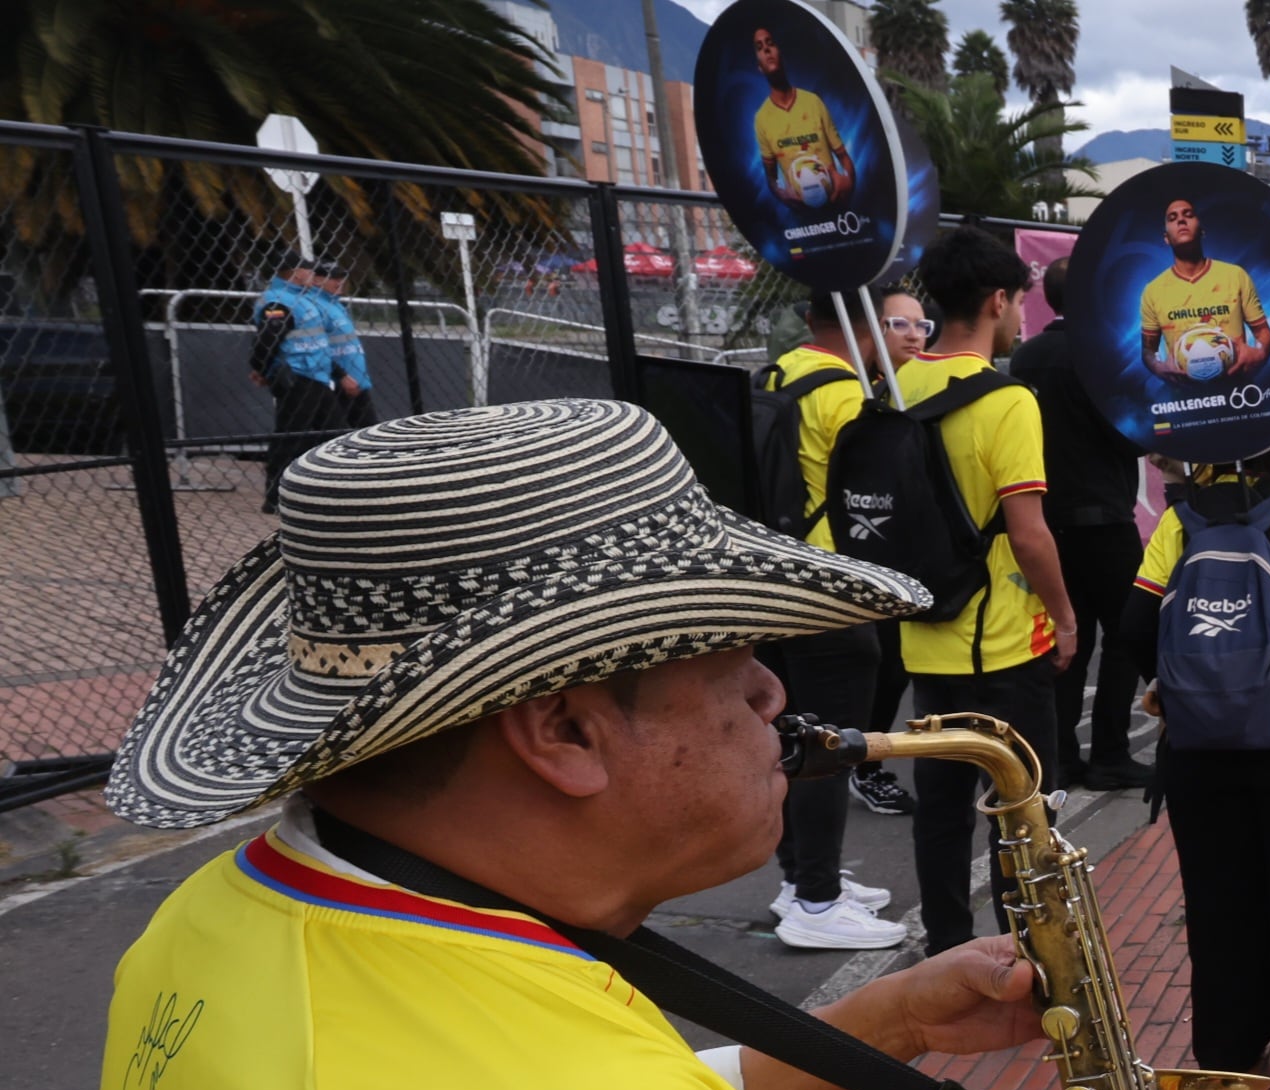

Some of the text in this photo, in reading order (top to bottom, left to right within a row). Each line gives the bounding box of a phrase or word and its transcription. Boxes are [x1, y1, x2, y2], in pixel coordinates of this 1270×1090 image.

[1173, 120, 1206, 128] INGRESO
[783, 220, 837, 240] CHALLENGER
[837, 211, 861, 235] 60
[1167, 304, 1230, 321] CHALLENGER
[1150, 394, 1227, 415] CHALLENGER
[1229, 383, 1262, 409] 60
